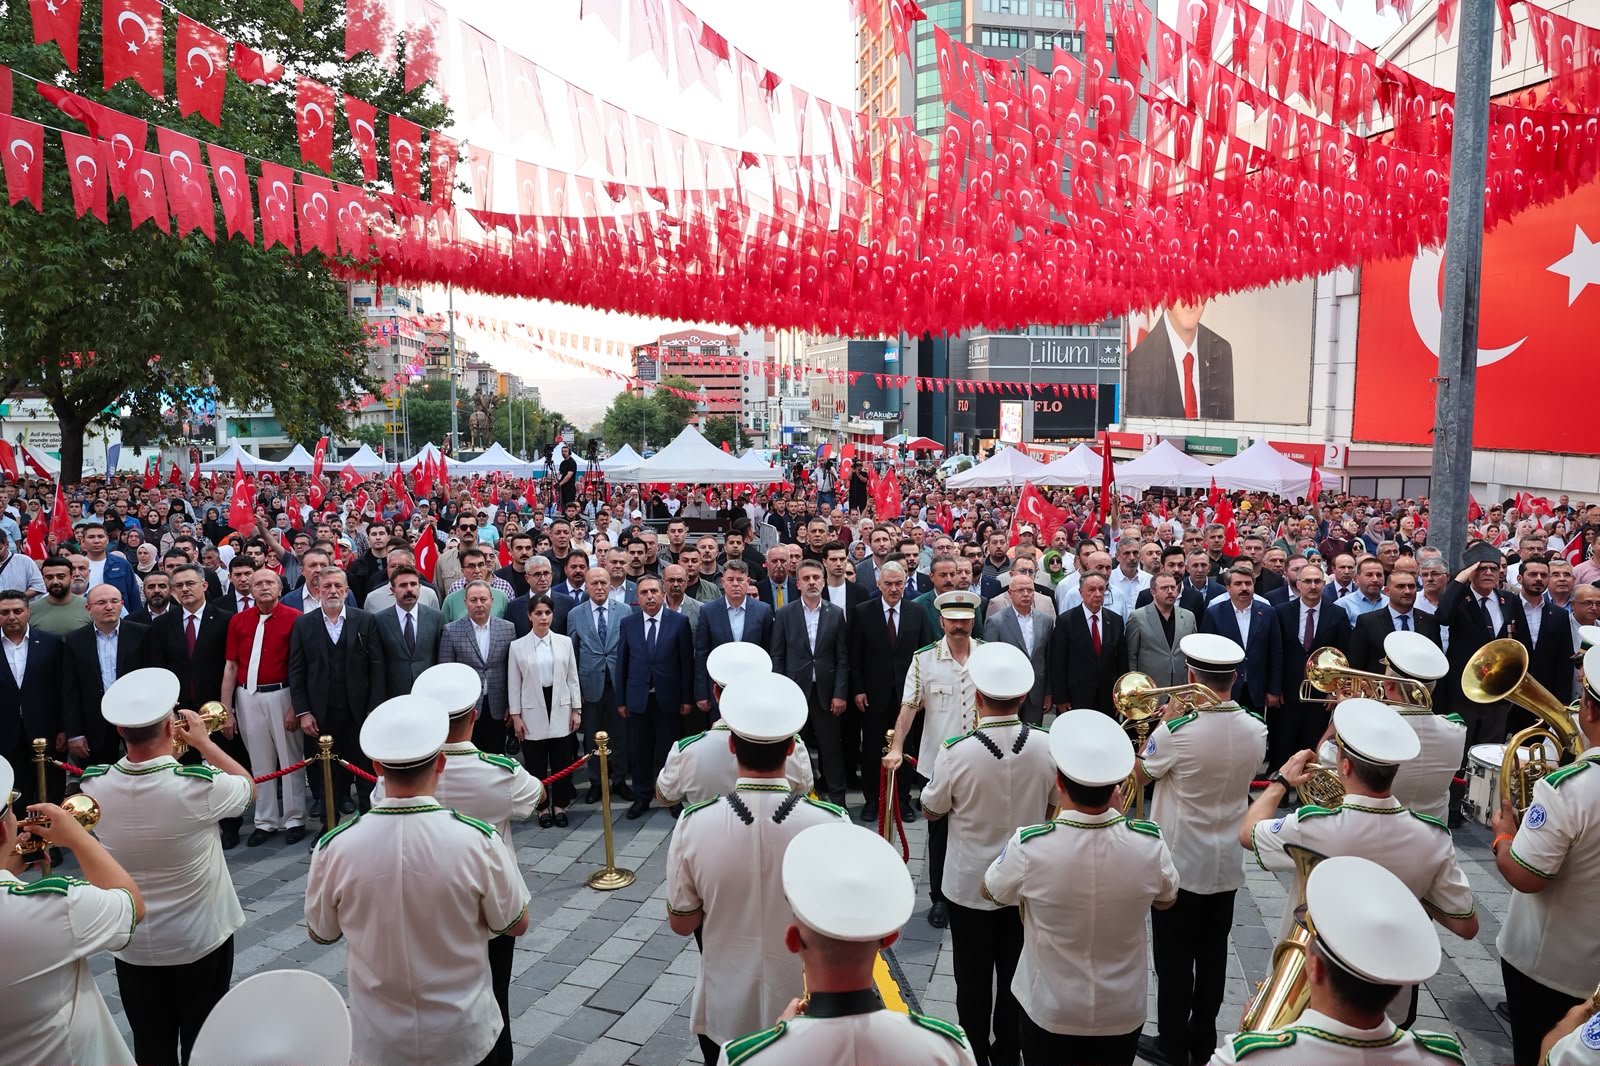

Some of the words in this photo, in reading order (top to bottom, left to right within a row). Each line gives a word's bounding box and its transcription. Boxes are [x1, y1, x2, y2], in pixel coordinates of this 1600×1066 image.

[1031, 341, 1089, 364] Lilium
[1098, 356, 1117, 364] Hotel
[957, 400, 969, 412] FLO
[1034, 400, 1063, 412] FLO
[873, 411, 898, 420] Akuğur
